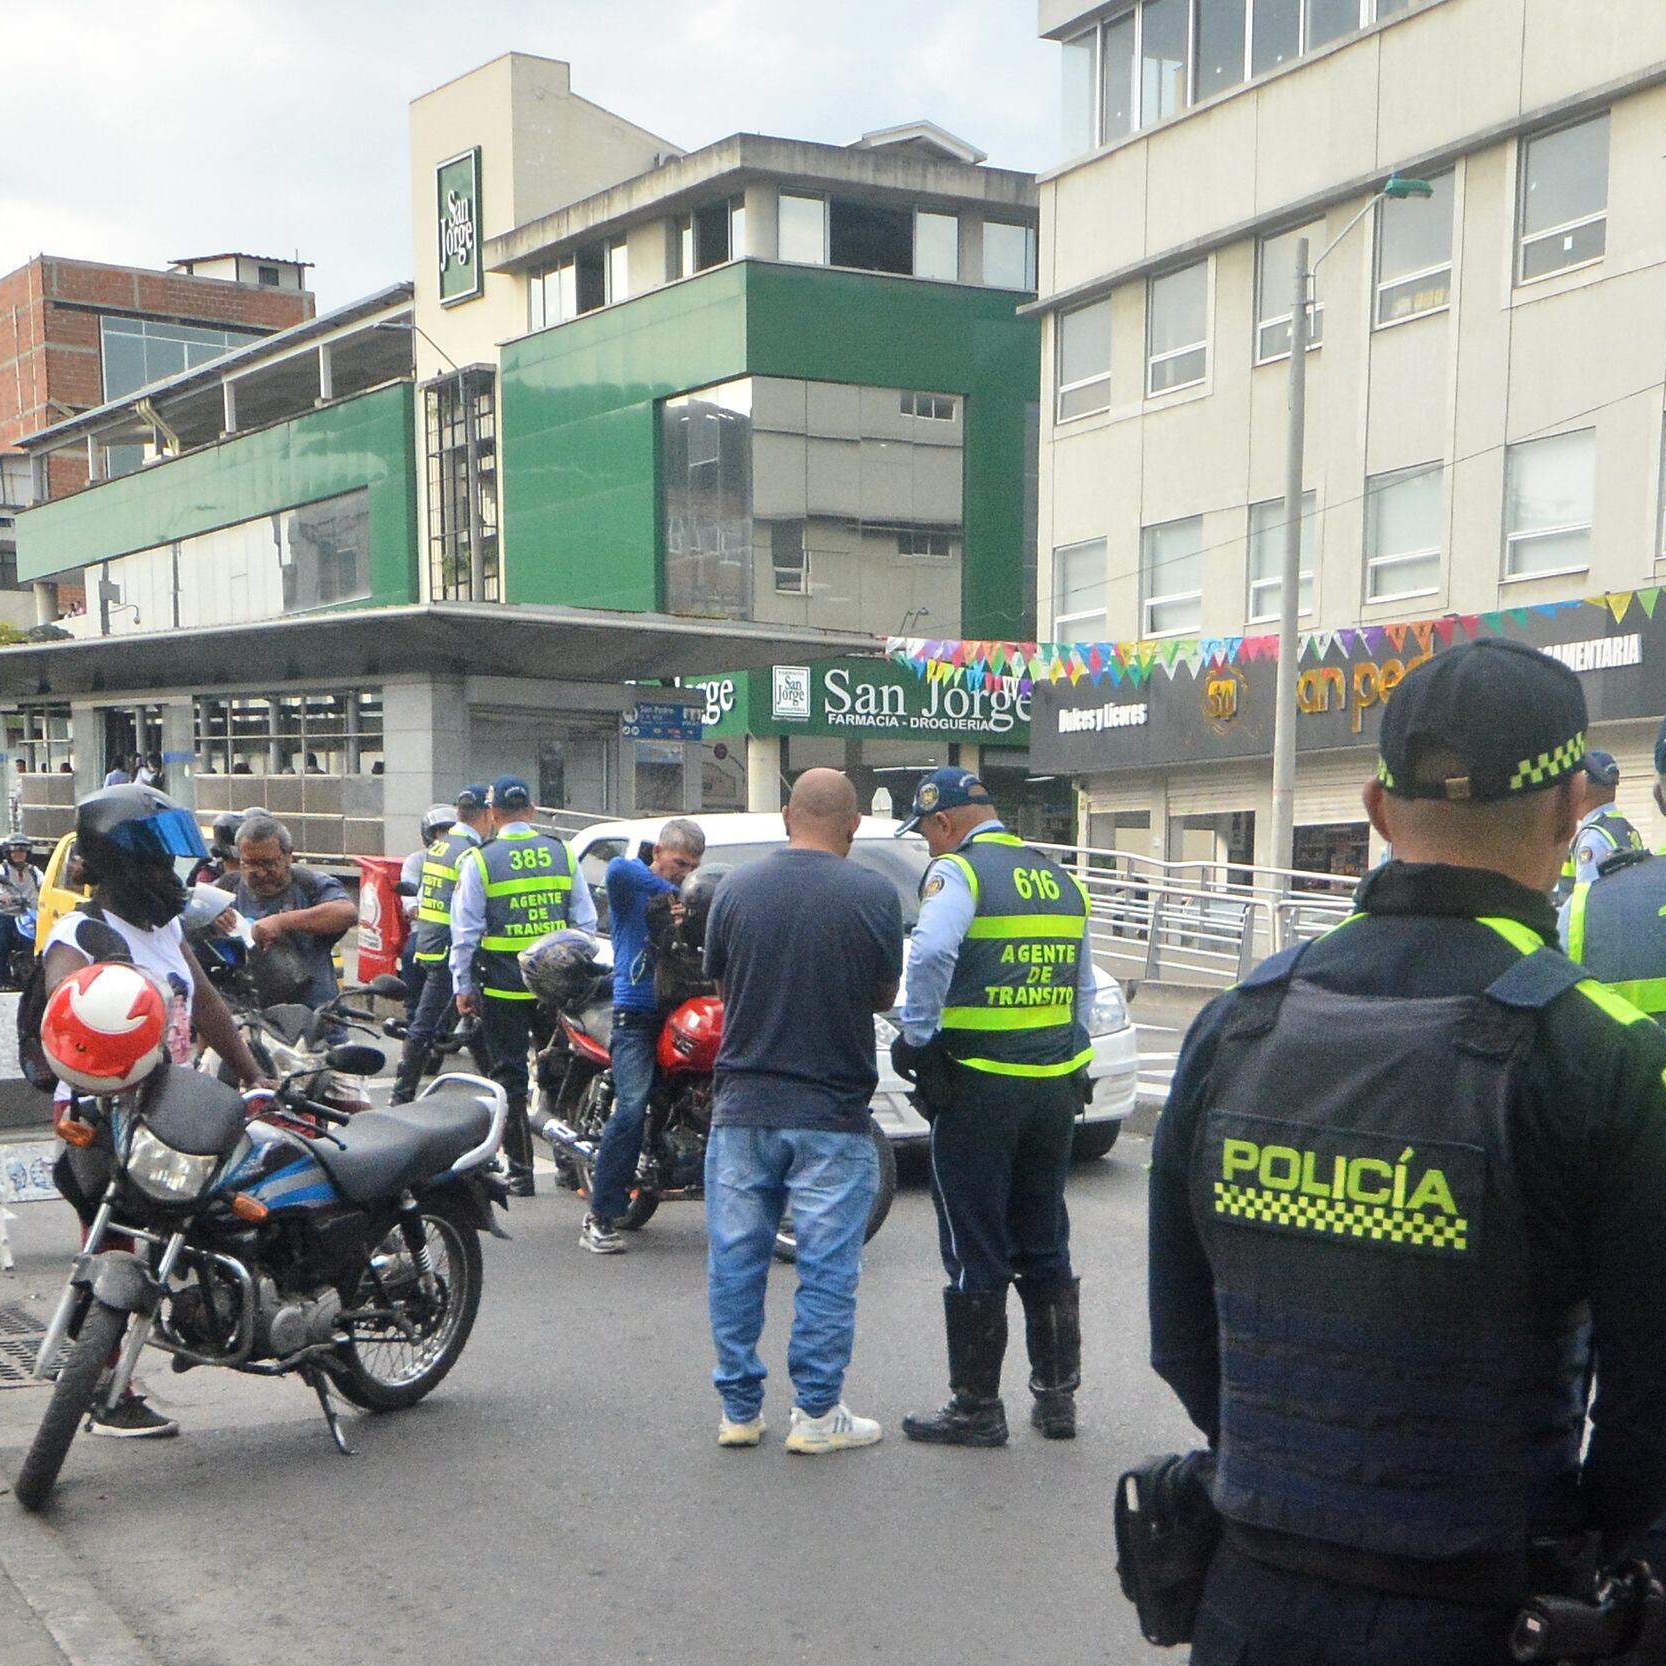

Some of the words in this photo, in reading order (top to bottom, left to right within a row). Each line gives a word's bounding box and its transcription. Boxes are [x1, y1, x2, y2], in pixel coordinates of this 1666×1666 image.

[447, 190, 470, 229] San
[440, 221, 474, 272] Jorge
[785, 675, 802, 691] San
[776, 684, 805, 706] Jorge
[824, 668, 908, 716] San
[921, 675, 1032, 733] Jorge
[828, 713, 900, 728] FARMACIA
[909, 716, 992, 732] DROGUERIA
[1058, 708, 1095, 733] Dulces
[1104, 702, 1148, 729] Licores
[508, 847, 552, 871] 385
[1013, 867, 1061, 900] 616
[509, 892, 562, 910] AGENTE
[528, 907, 549, 921] DE
[504, 919, 568, 936] TRANSITO
[1000, 944, 1076, 964] AGENTE
[1026, 966, 1054, 984] DE
[985, 986, 1075, 1006] TRANSITO
[1222, 1138, 1459, 1216] POLICÍA
